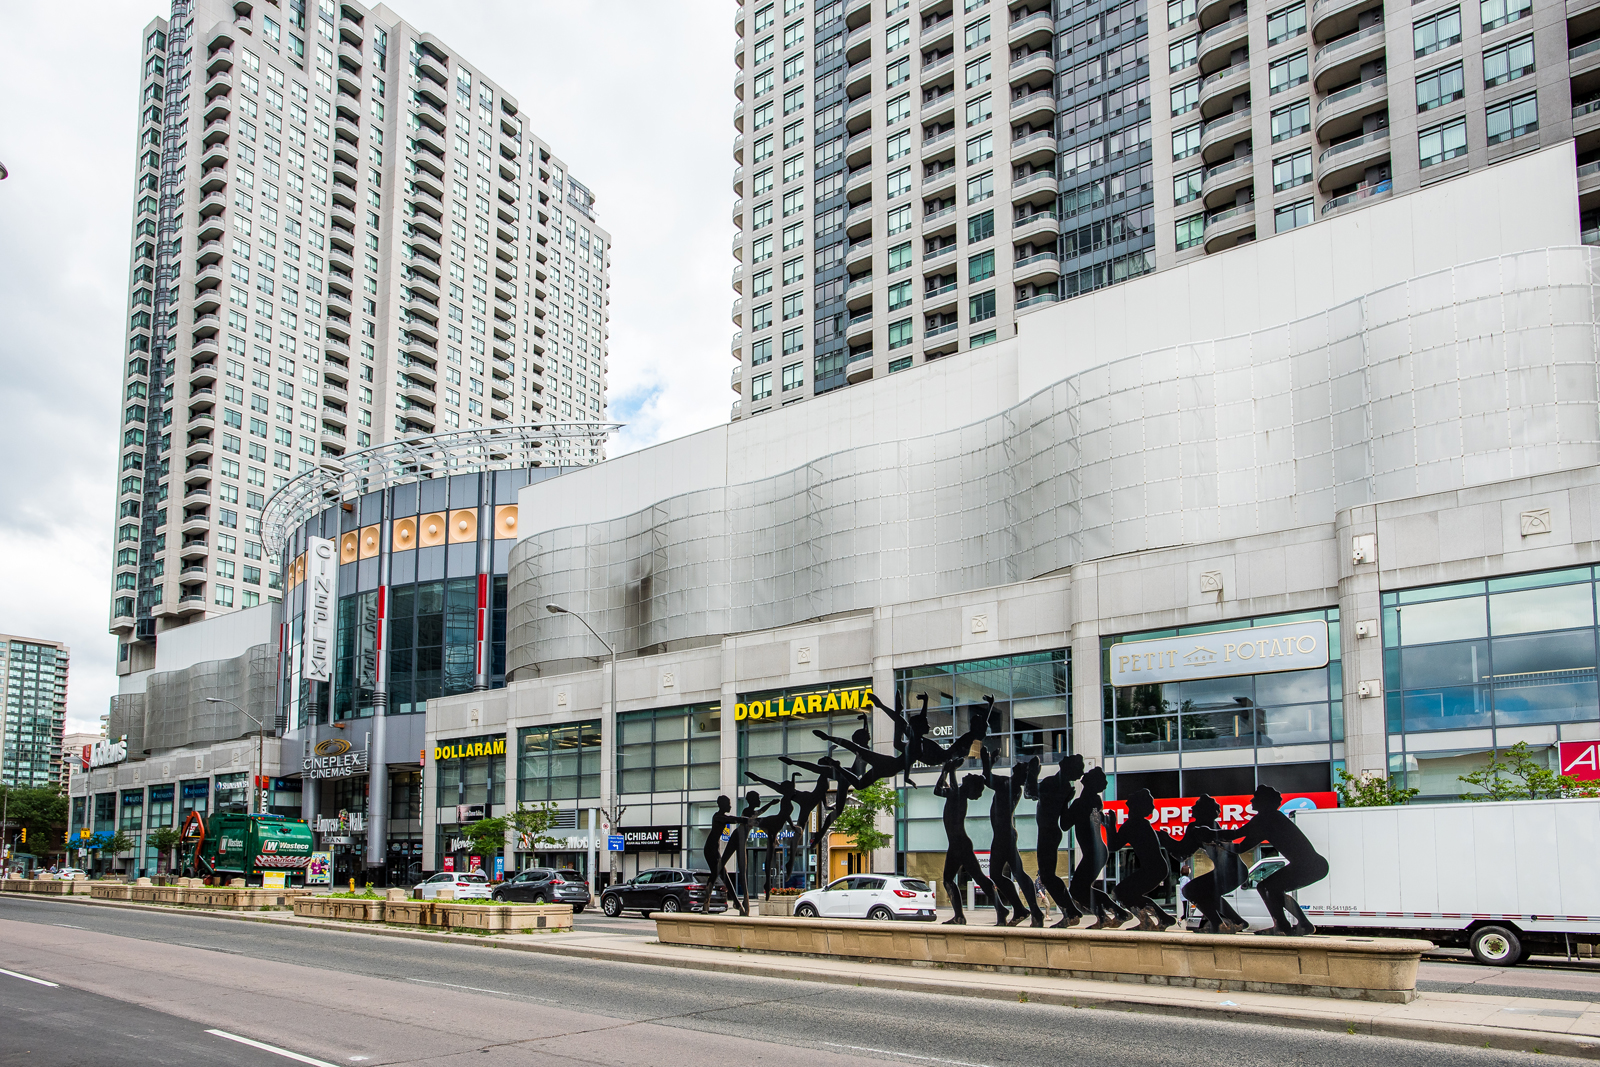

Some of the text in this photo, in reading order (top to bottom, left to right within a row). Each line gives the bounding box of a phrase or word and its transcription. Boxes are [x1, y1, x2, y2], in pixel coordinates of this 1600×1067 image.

[311, 544, 331, 677] CINEPLEX
[1118, 635, 1317, 673] PETIT POTATO
[734, 688, 874, 721] DOLLARAMA
[434, 740, 507, 760] DOLLARAM
[1563, 744, 1600, 772] A
[303, 753, 361, 769] CINEPLEX
[310, 767, 352, 779] CINEMAS
[316, 812, 364, 832] Empress Walk
[1102, 803, 1259, 826] HPPRS
[451, 835, 476, 853] Wendy'
[567, 836, 601, 849] Mobe
[624, 832, 659, 841] ICHIBAN
